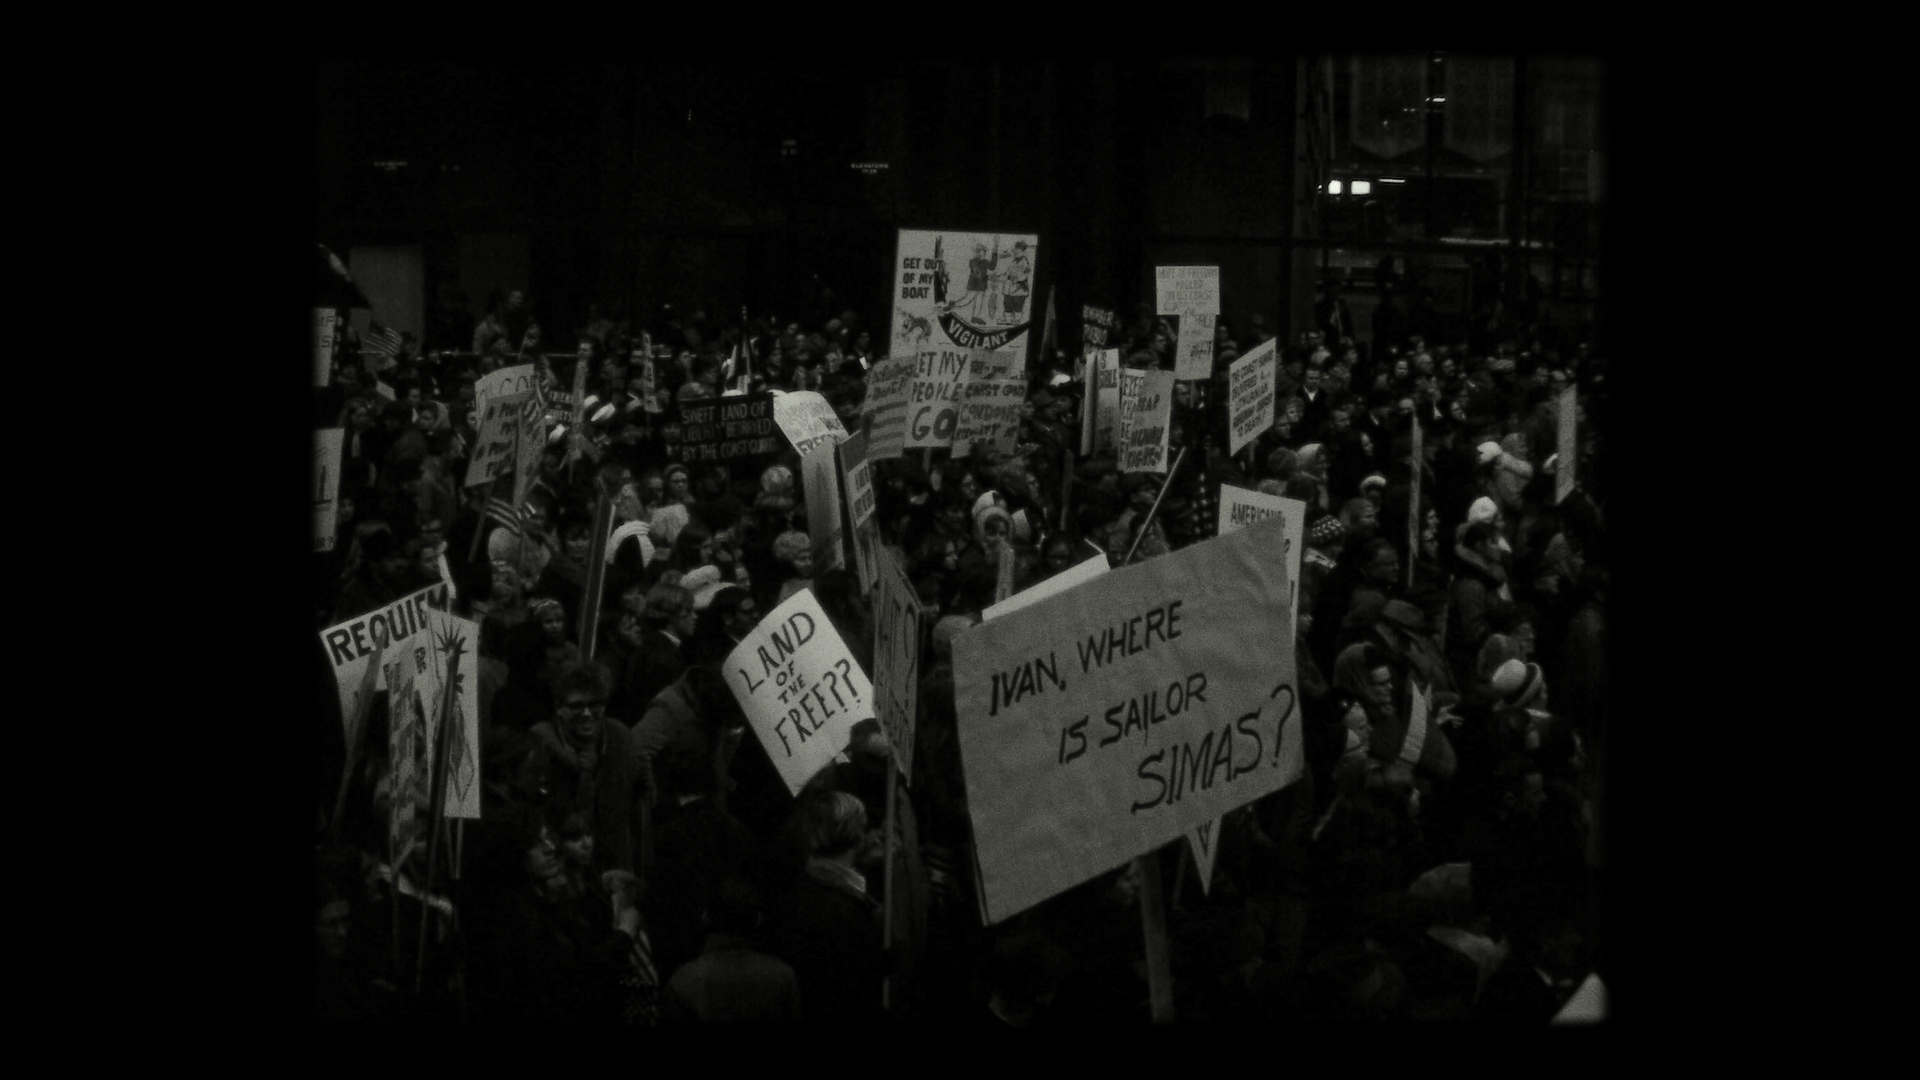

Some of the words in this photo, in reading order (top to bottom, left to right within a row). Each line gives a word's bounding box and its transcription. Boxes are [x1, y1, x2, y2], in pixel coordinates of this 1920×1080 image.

[903, 258, 920, 269] GET
[924, 259, 944, 270] OUT
[903, 273, 916, 284] OF
[919, 273, 934, 285] MY
[902, 286, 930, 299] BOAT
[949, 319, 1009, 349] VIGILANT
[940, 351, 968, 382] MY
[911, 382, 963, 403] PEOPLE
[721, 403, 748, 421] LAND
[750, 401, 767, 417] OF
[911, 406, 958, 441] GO
[727, 418, 772, 438] BETRAYED
[682, 446, 697, 462] BY
[699, 443, 717, 460] THE
[721, 439, 748, 458] COAST
[738, 611, 816, 695] LAND
[989, 651, 1067, 717] IVAN,
[1077, 600, 1185, 674] WHERE
[775, 659, 796, 690] OF
[778, 676, 809, 706] THE
[773, 657, 860, 757] FREE??
[1059, 723, 1089, 765] IS
[1098, 673, 1209, 747] SAILOR
[1131, 684, 1296, 814] SIMAS?
